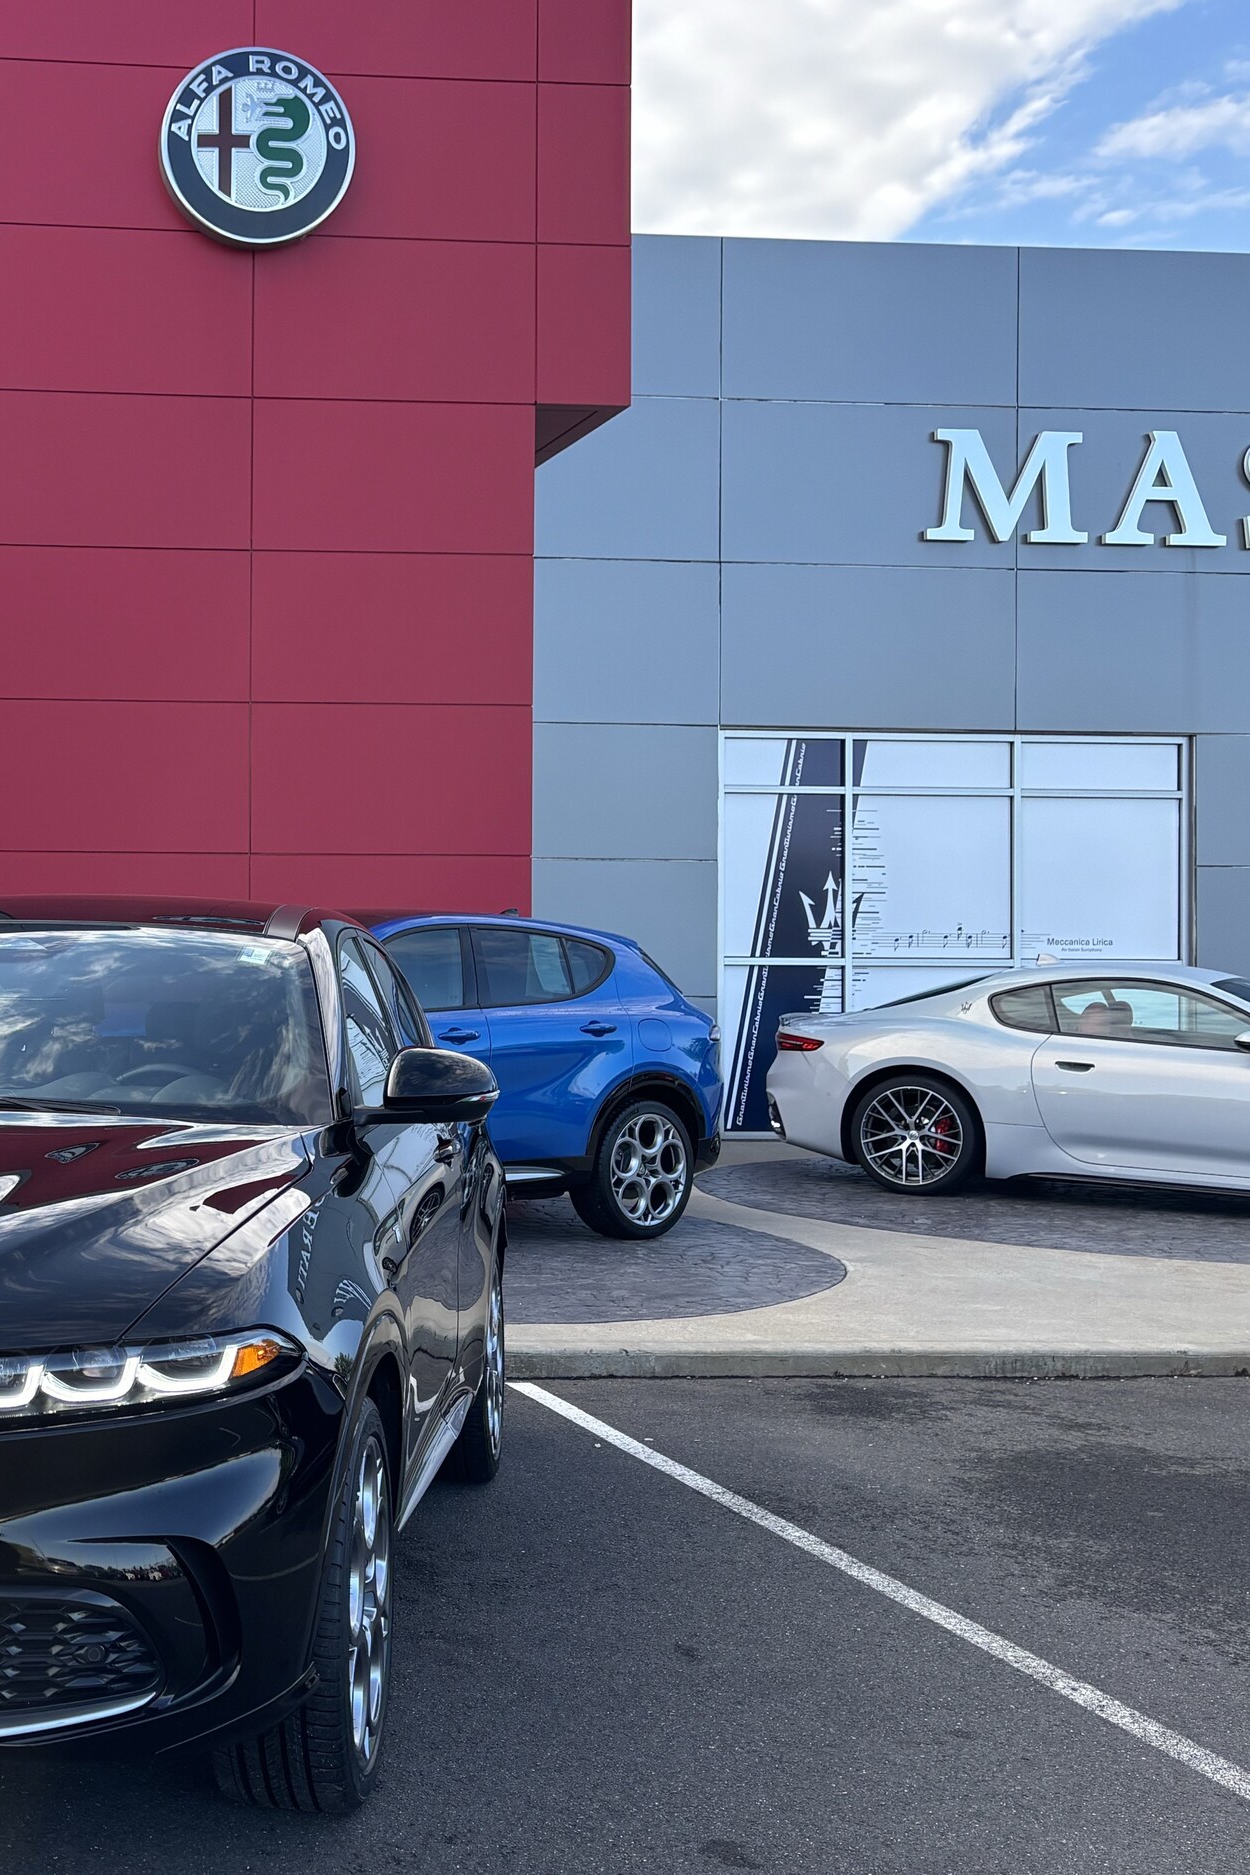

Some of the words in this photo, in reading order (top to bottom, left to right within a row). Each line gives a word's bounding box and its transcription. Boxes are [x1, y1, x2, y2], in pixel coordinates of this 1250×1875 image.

[171, 64, 234, 141] ALFA
[249, 54, 348, 151] ROMEO
[924, 428, 1250, 550] MA
[1046, 937, 1090, 946] Meccanica
[1092, 937, 1114, 946] Lirica
